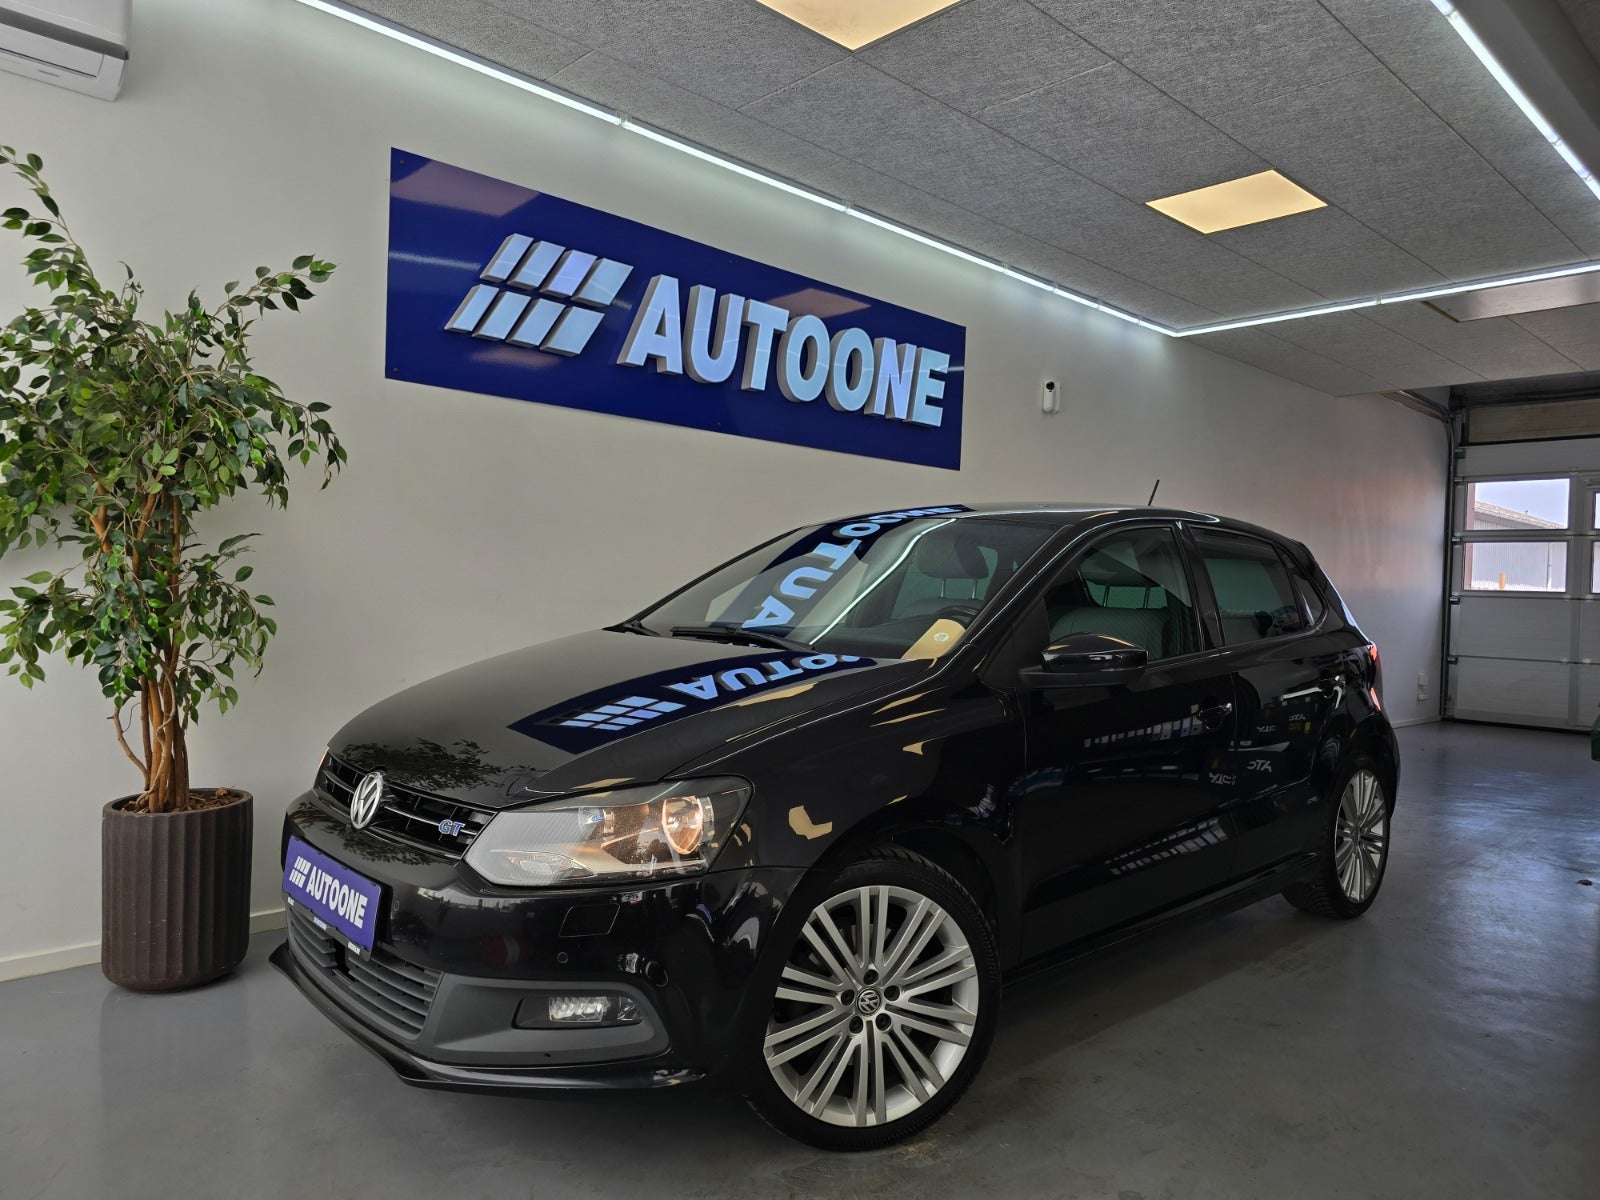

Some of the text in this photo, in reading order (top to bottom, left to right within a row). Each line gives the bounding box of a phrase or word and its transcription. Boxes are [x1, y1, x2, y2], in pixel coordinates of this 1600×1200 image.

[617, 274, 950, 427] AUTOONE
[438, 819, 466, 837] GT
[306, 865, 368, 929] AUTOONE
